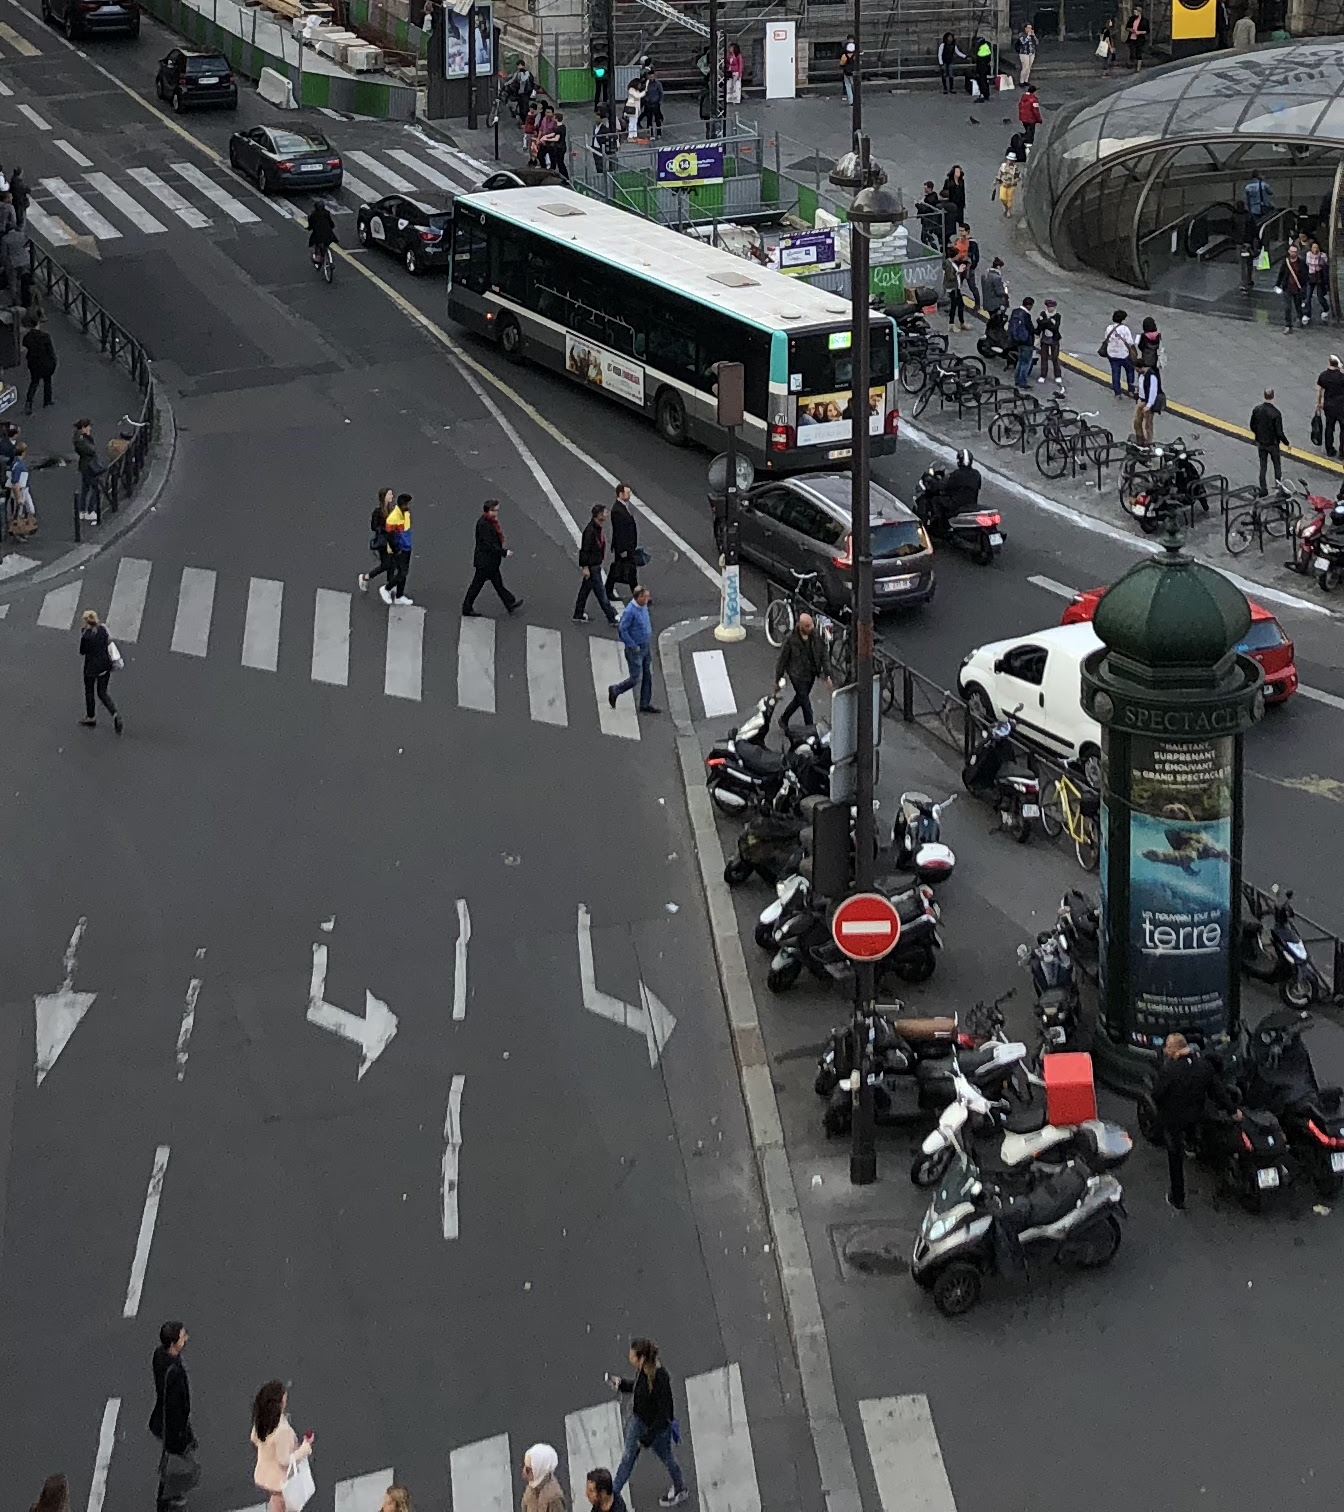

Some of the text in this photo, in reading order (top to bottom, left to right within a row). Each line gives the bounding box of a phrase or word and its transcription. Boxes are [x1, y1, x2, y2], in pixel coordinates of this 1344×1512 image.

[777, 414, 786, 424] 70
[1153, 750, 1216, 761] SURPRENANT
[1141, 915, 1221, 950] terre
